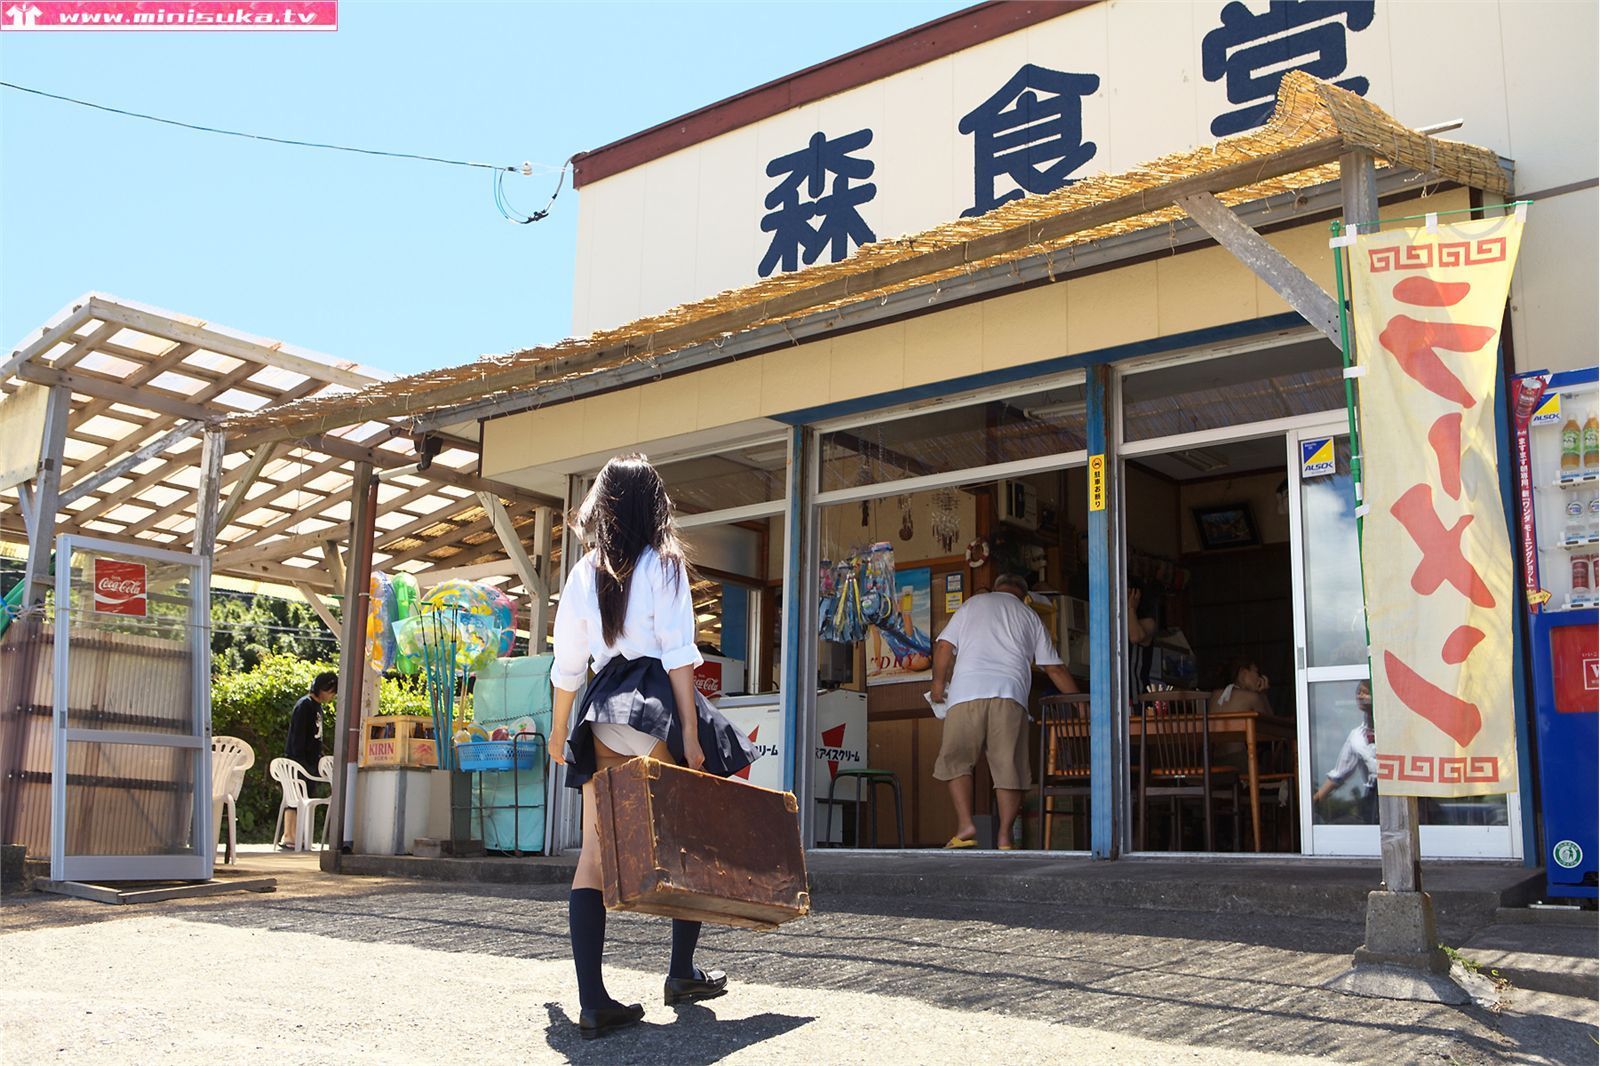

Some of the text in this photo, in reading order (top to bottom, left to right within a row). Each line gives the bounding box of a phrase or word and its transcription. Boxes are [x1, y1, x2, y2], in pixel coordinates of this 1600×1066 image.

[1304, 461, 1334, 472] ALSOK
[1379, 275, 1497, 748] ラーメン
[98, 577, 142, 594] Coca-Cola
[368, 742, 395, 756] KIRIN
